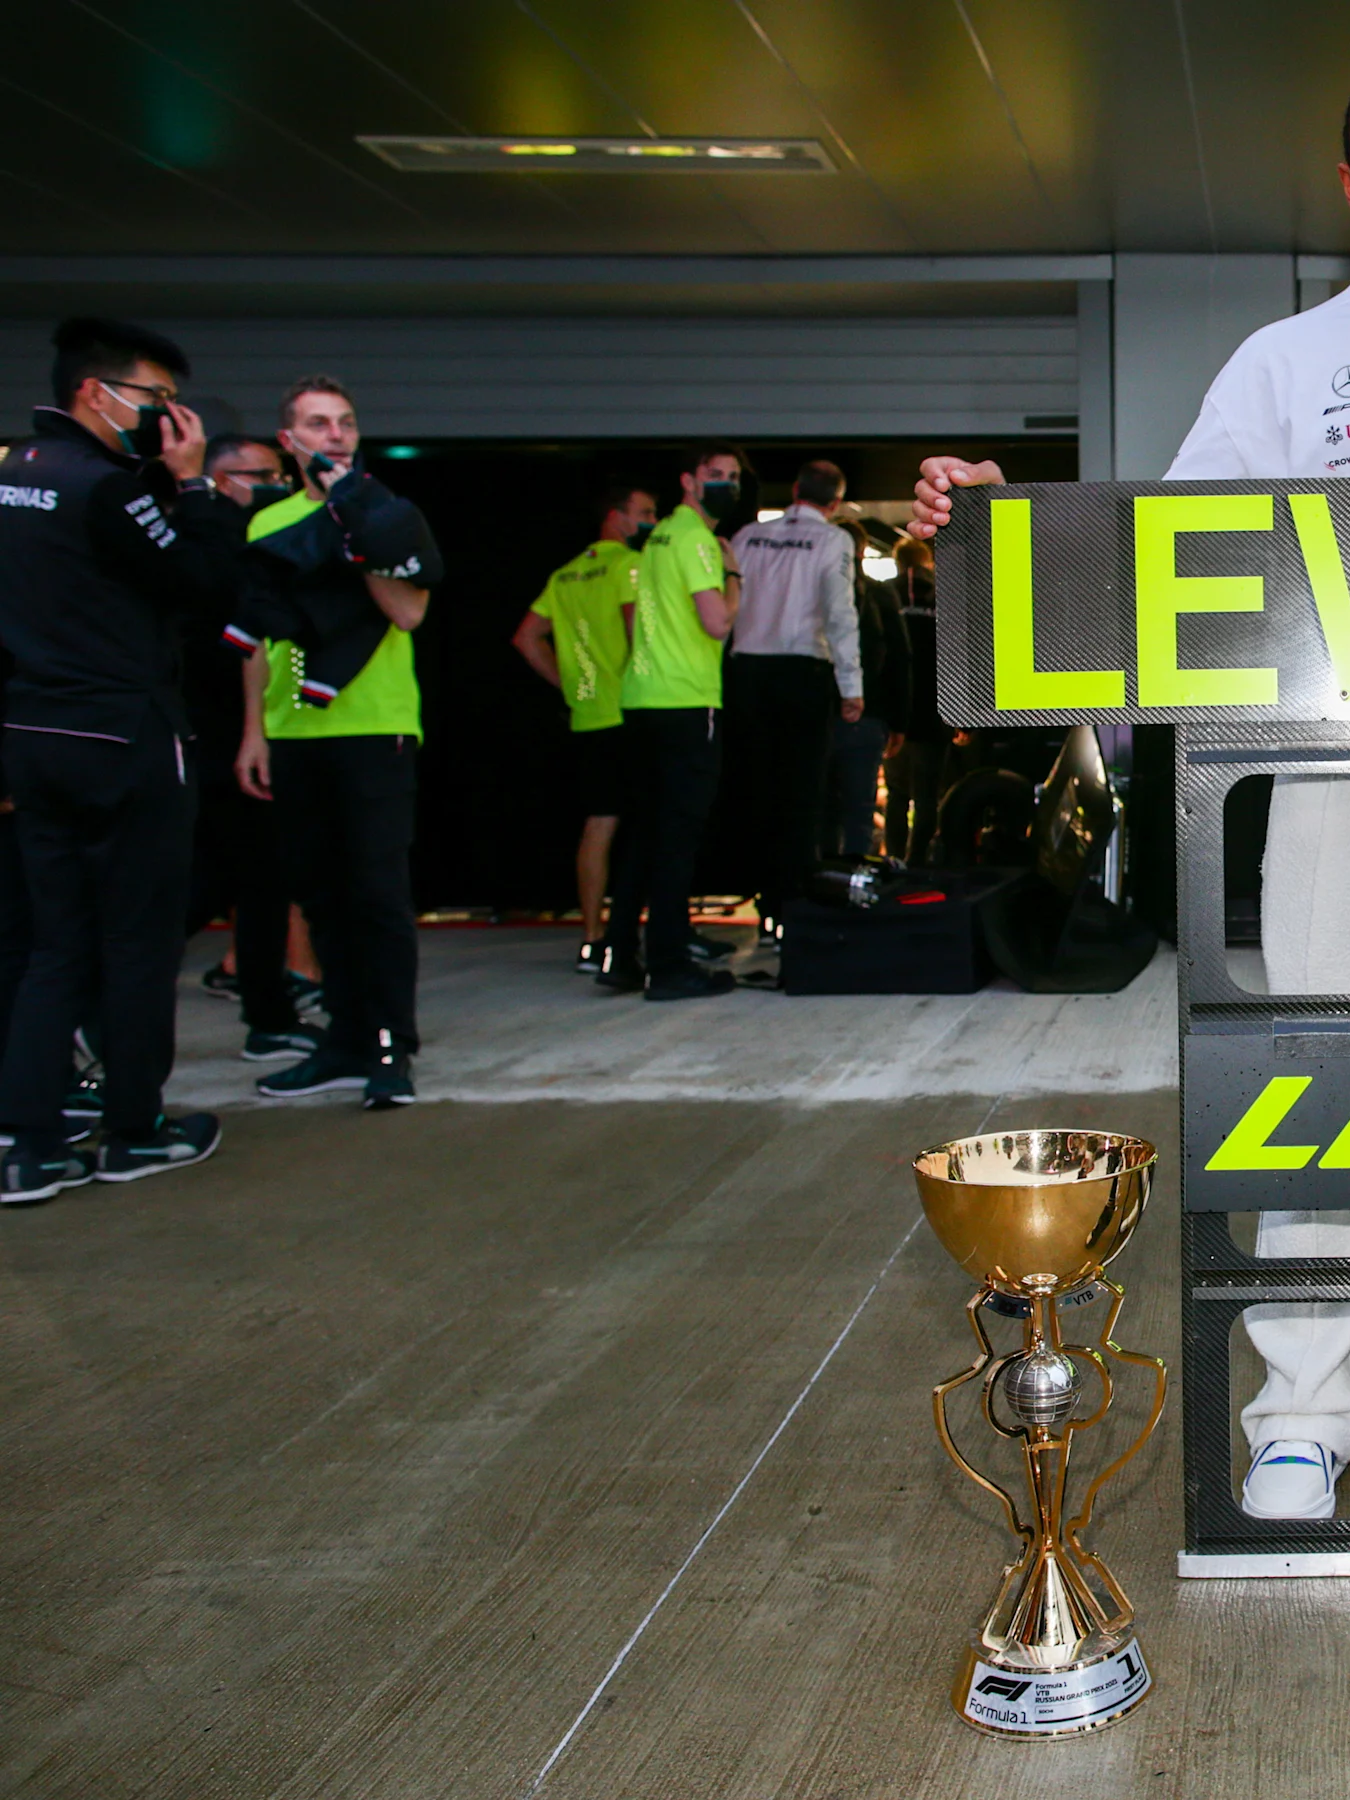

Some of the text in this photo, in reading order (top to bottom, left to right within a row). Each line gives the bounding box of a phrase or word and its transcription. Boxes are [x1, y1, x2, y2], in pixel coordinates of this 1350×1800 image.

[1073, 1290, 1094, 1306] VTB
[1117, 1653, 1140, 1685] 1
[1035, 1678, 1118, 1704] RUSSIAN GRAND PRIX 2021
[969, 1697, 1028, 1725] Formula 1
